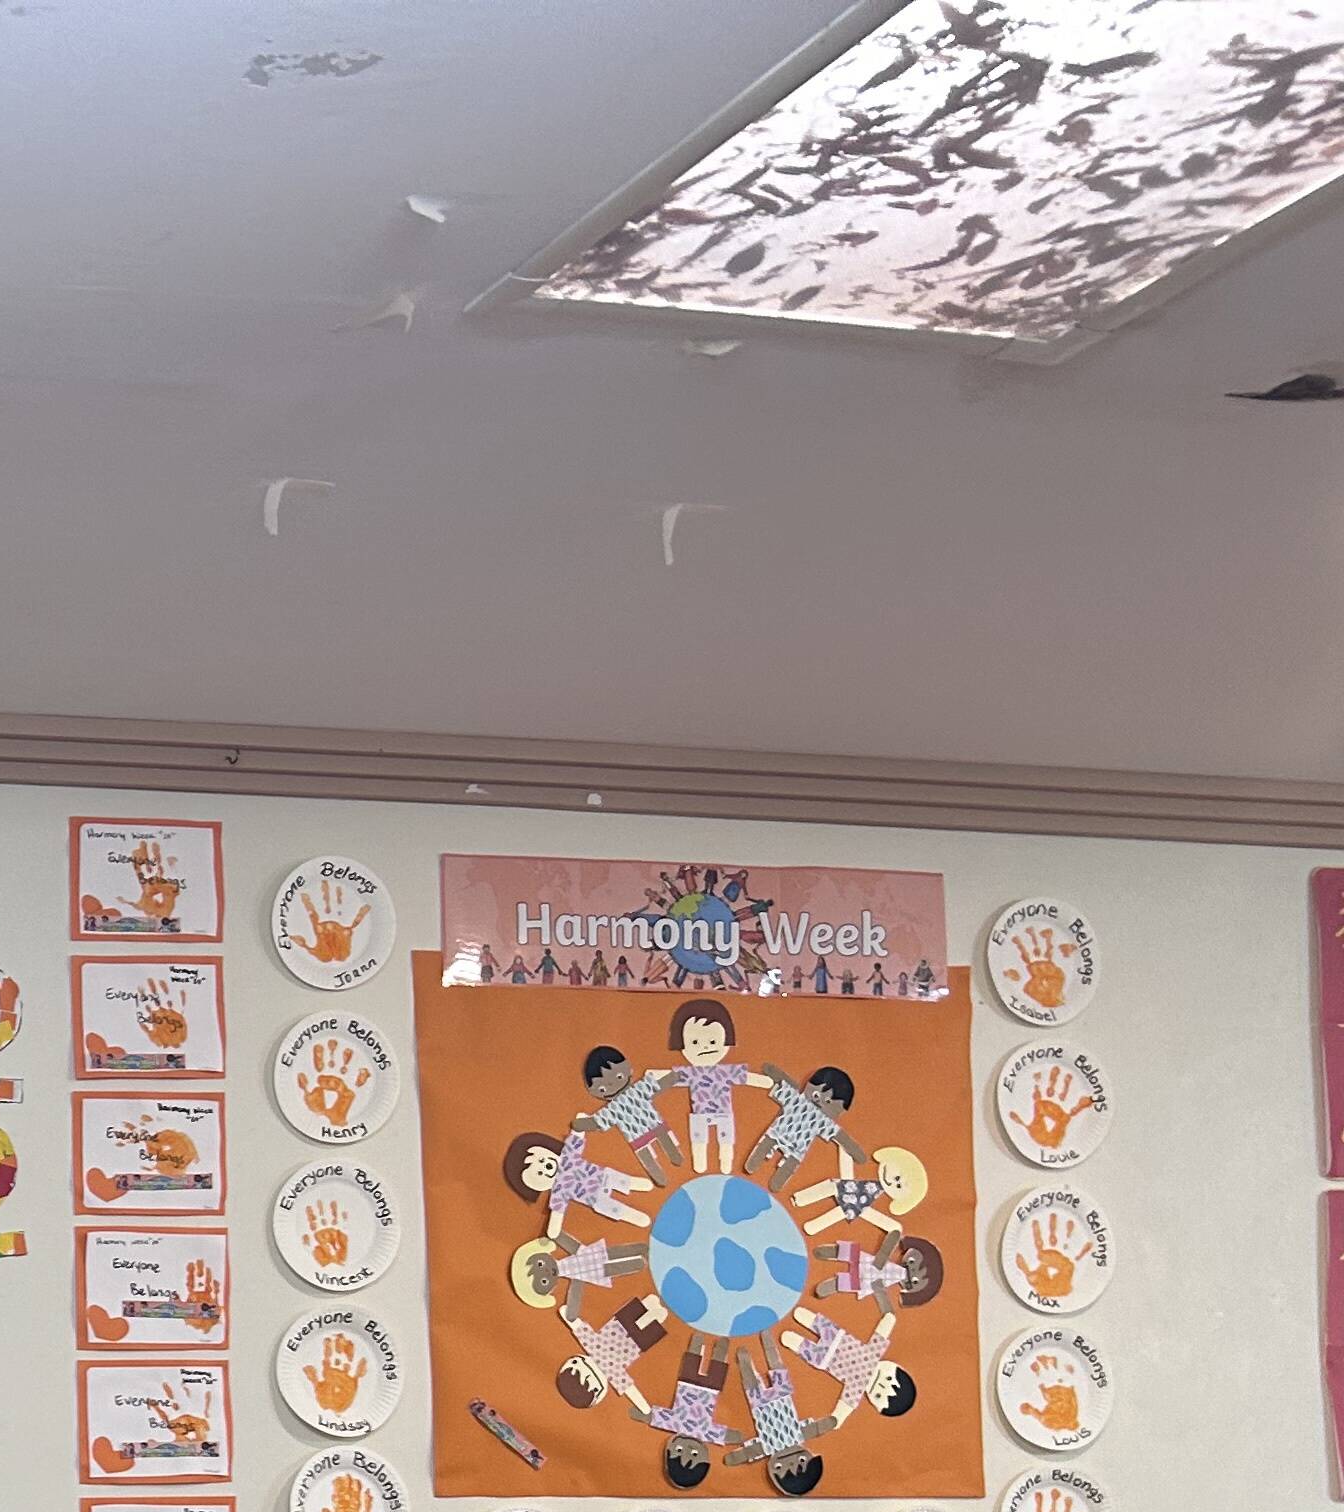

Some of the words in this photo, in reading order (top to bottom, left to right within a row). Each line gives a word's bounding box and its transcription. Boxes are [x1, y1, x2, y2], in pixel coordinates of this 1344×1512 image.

[516, 902, 740, 967] Harmony
[760, 910, 889, 957] Week
[281, 1018, 338, 1068] Everyone
[347, 1020, 392, 1072] Belongs
[1003, 1047, 1063, 1093] Everyone
[1074, 1055, 1108, 1113] Belongs
[321, 1122, 368, 1139] Henry
[280, 1164, 343, 1211] Everyone
[354, 1168, 393, 1227] Belongs
[314, 1267, 374, 1286] Vincent
[1051, 1469, 1104, 1505] Belongs
